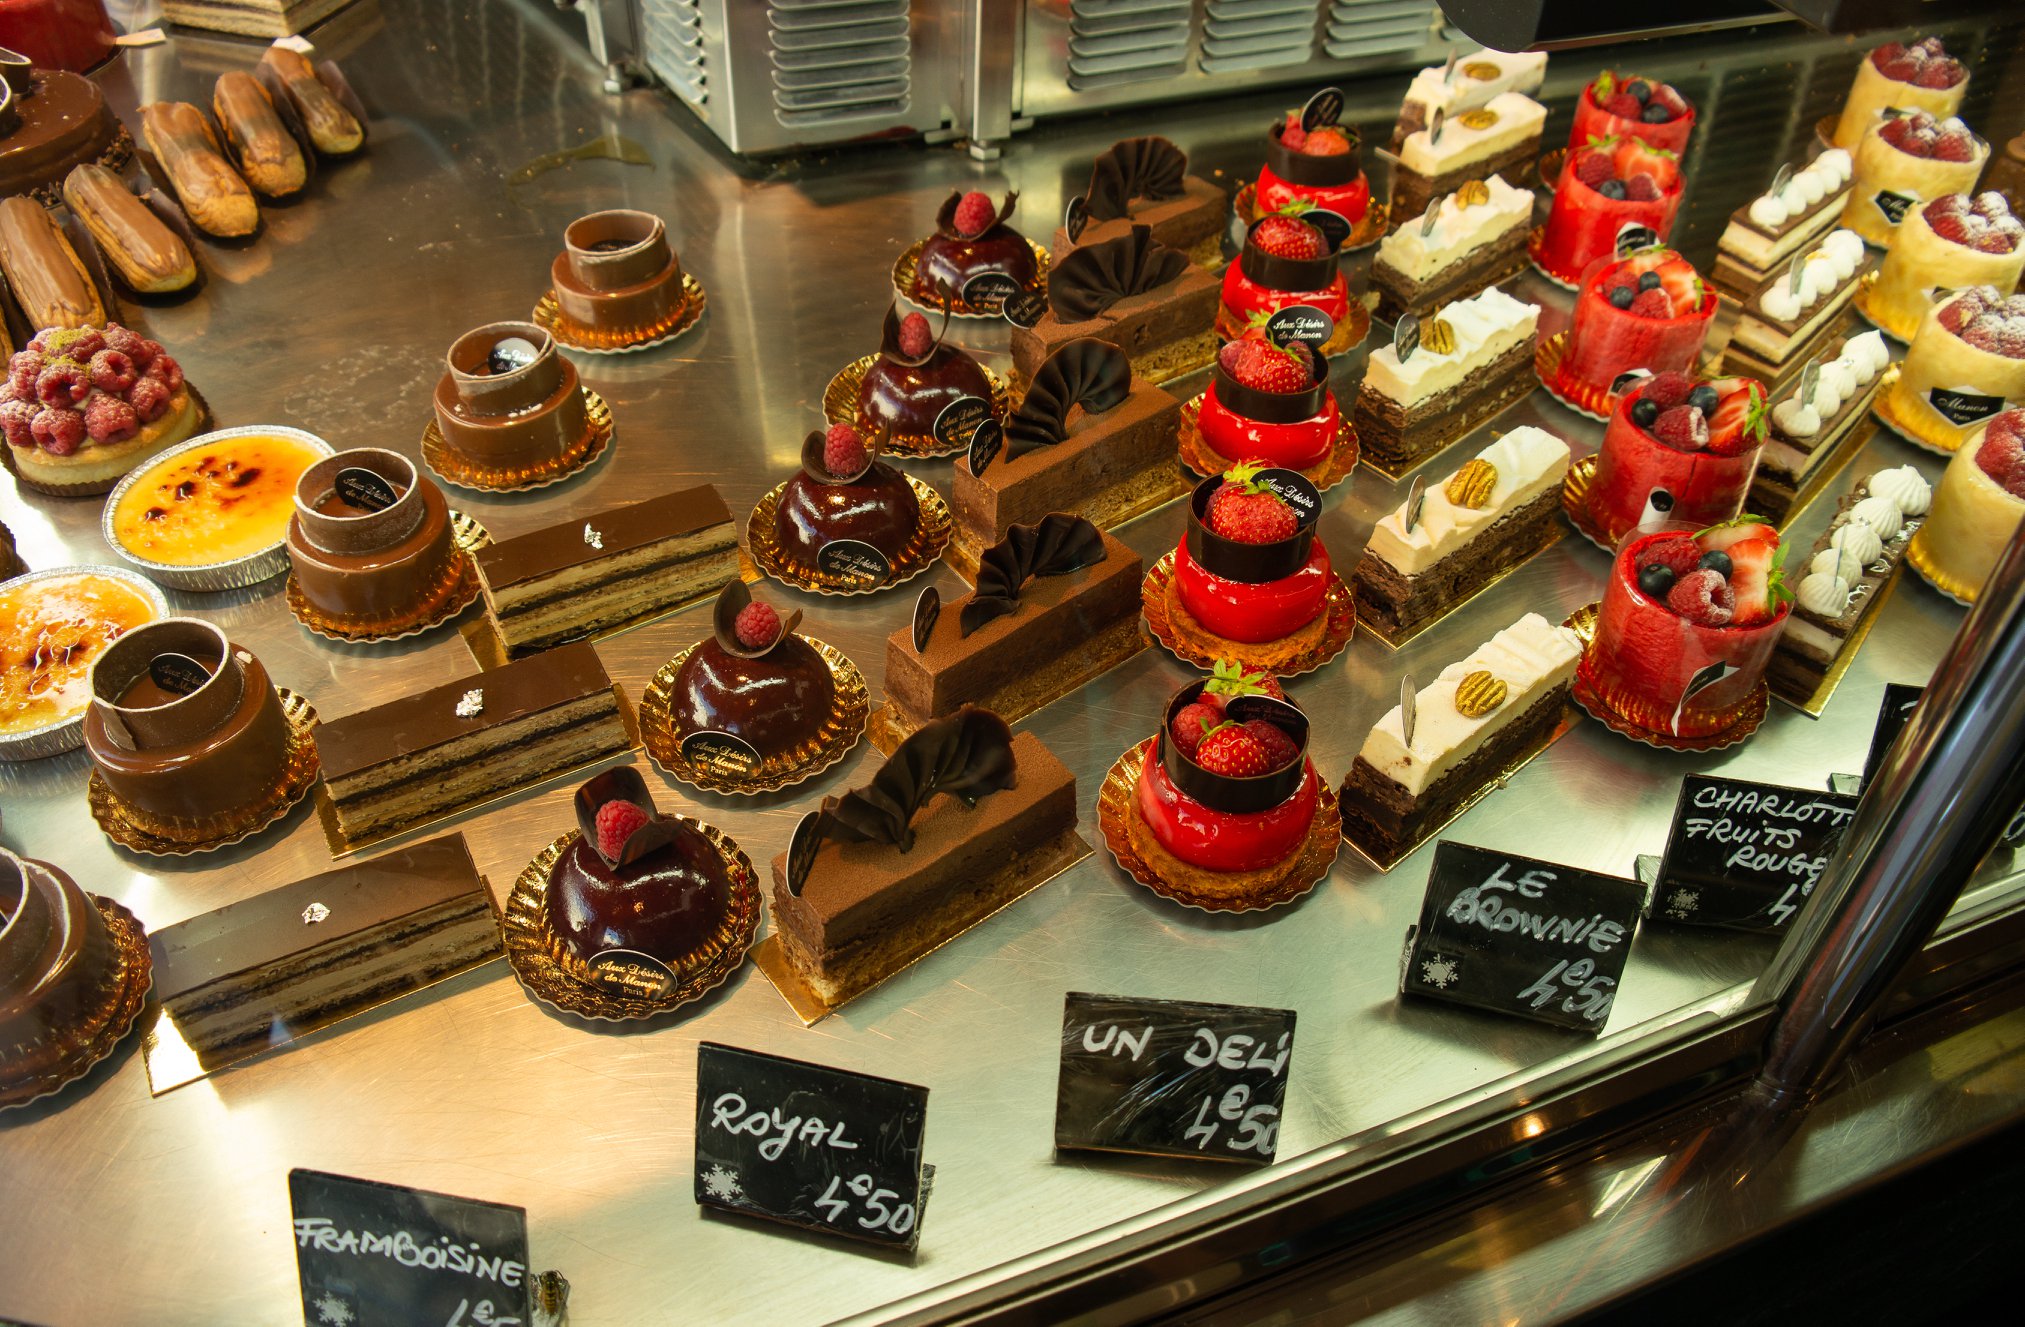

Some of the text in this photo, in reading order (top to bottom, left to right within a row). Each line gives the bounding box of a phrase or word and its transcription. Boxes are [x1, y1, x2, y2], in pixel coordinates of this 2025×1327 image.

[1273, 318, 1295, 330] Aux
[1278, 328, 1322, 340] de Manon
[1937, 396, 1988, 412] Manon
[827, 549, 852, 562] Aux
[829, 560, 875, 581] de Manon
[840, 573, 857, 585] Paris
[691, 741, 718, 754] Aux
[695, 752, 747, 773] de Manon
[710, 765, 728, 777] Paris
[1693, 786, 1857, 827] CHARLOTT
[1685, 818, 1802, 849] FRUITS
[1478, 861, 1558, 898] LE
[597, 960, 665, 980] Aux Désirs
[603, 972, 662, 990] de Manon
[623, 986, 643, 997] Paris
[1082, 1024, 1154, 1062] UN
